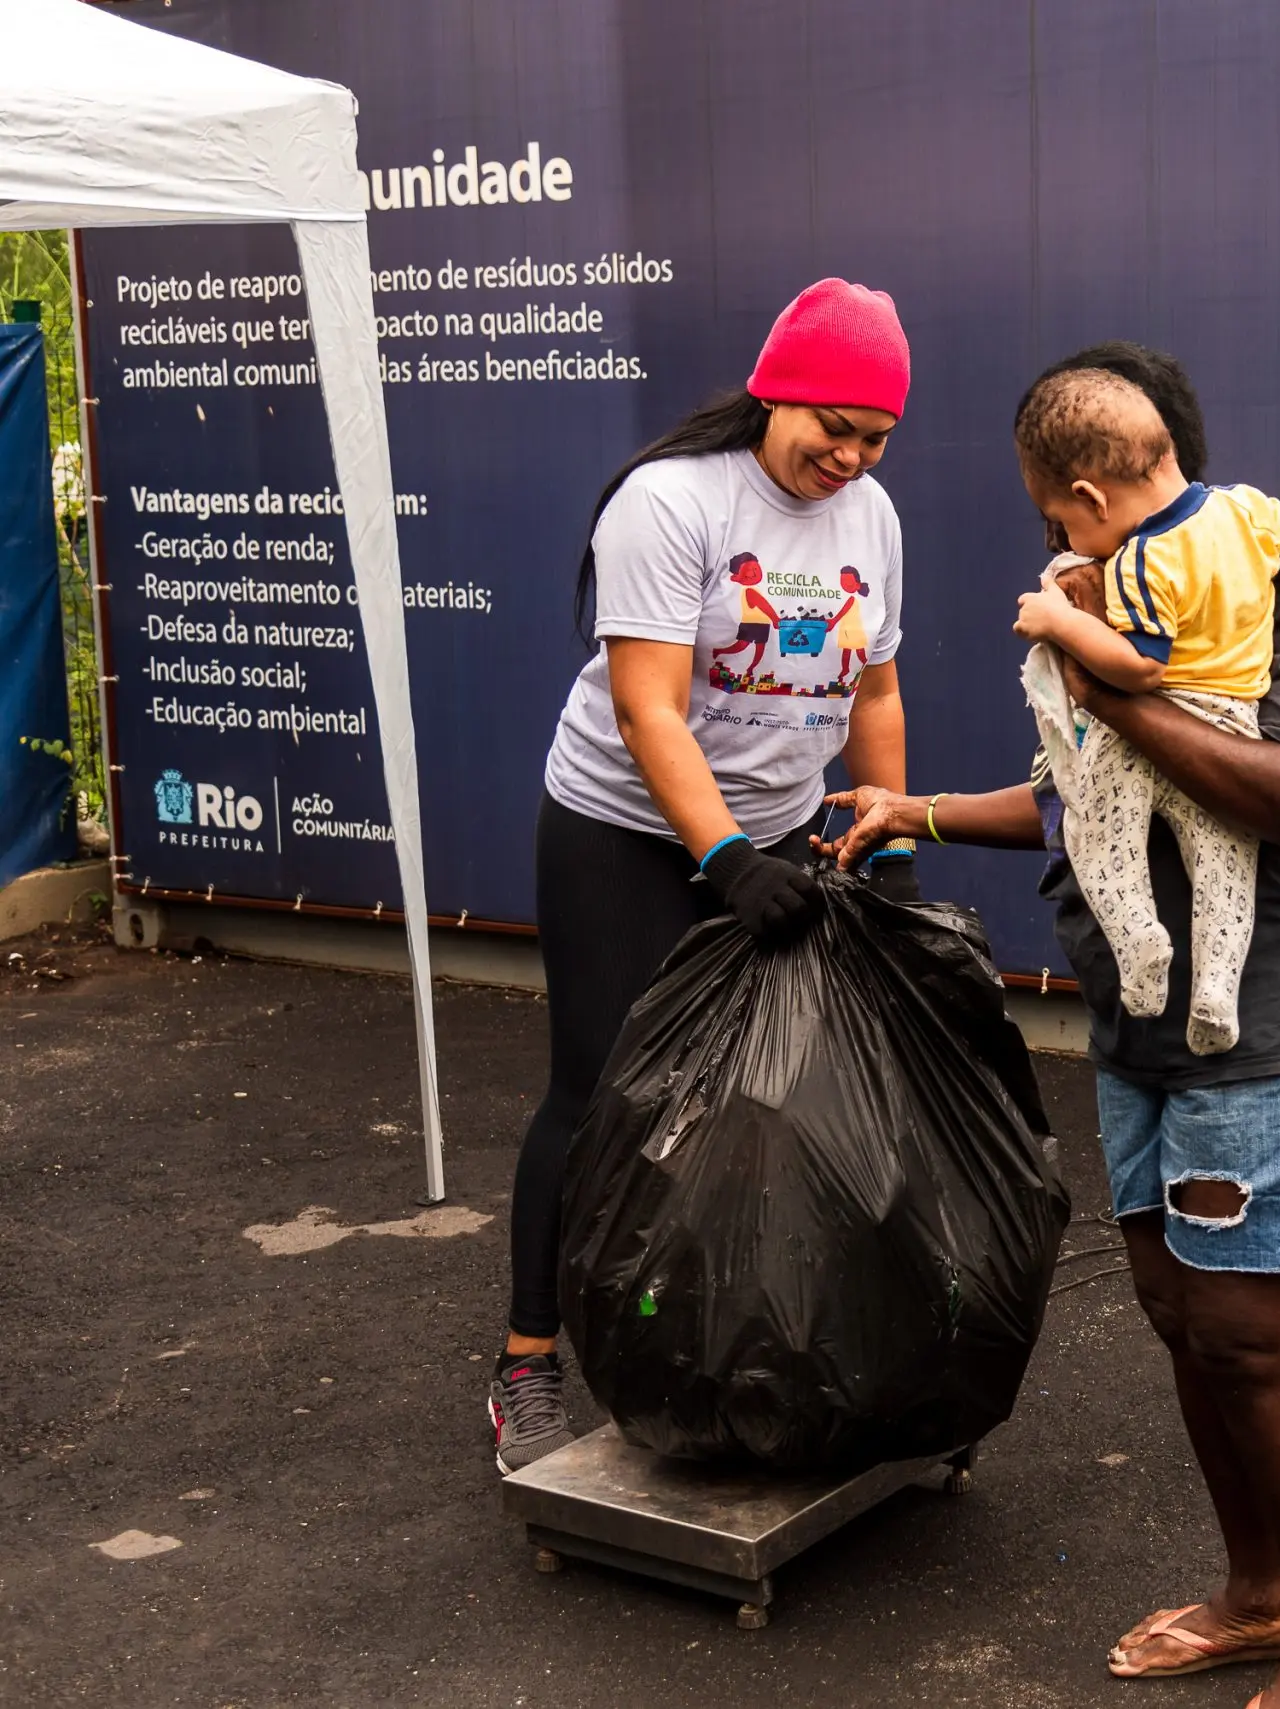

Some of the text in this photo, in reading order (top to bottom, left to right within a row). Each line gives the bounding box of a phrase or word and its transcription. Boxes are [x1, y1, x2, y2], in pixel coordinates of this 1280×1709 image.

[117, 275, 192, 309] Projeto
[197, 271, 224, 300] de
[438, 259, 468, 289] de
[474, 256, 577, 288] resíduos
[583, 251, 674, 284] sólidos
[120, 315, 227, 345] recicláveis
[232, 319, 274, 349] que
[445, 313, 474, 336] na
[480, 302, 603, 342] qualidade
[122, 358, 228, 388] ambiental
[417, 353, 480, 382] áreas
[485, 349, 648, 381] beneficiadas.
[130, 486, 250, 520] Vantagens
[254, 486, 284, 514] da
[135, 531, 335, 565] -Geração de renda;
[137, 572, 341, 608] -Reaproveitamento
[403, 581, 493, 613] ateriais;
[766, 571, 822, 587] RECICLA
[767, 586, 842, 600] COMUNIDADE
[140, 614, 354, 652] -Defesa da natureza;
[142, 656, 306, 692] -Inclusão social;
[145, 696, 366, 735] -Educação ambiental
[816, 714, 834, 726] Rio
[197, 782, 263, 831] Rio
[292, 794, 334, 816] AÇÃO
[159, 831, 264, 853] PREFEITURA
[292, 818, 396, 841] COMUNITÁRIA
